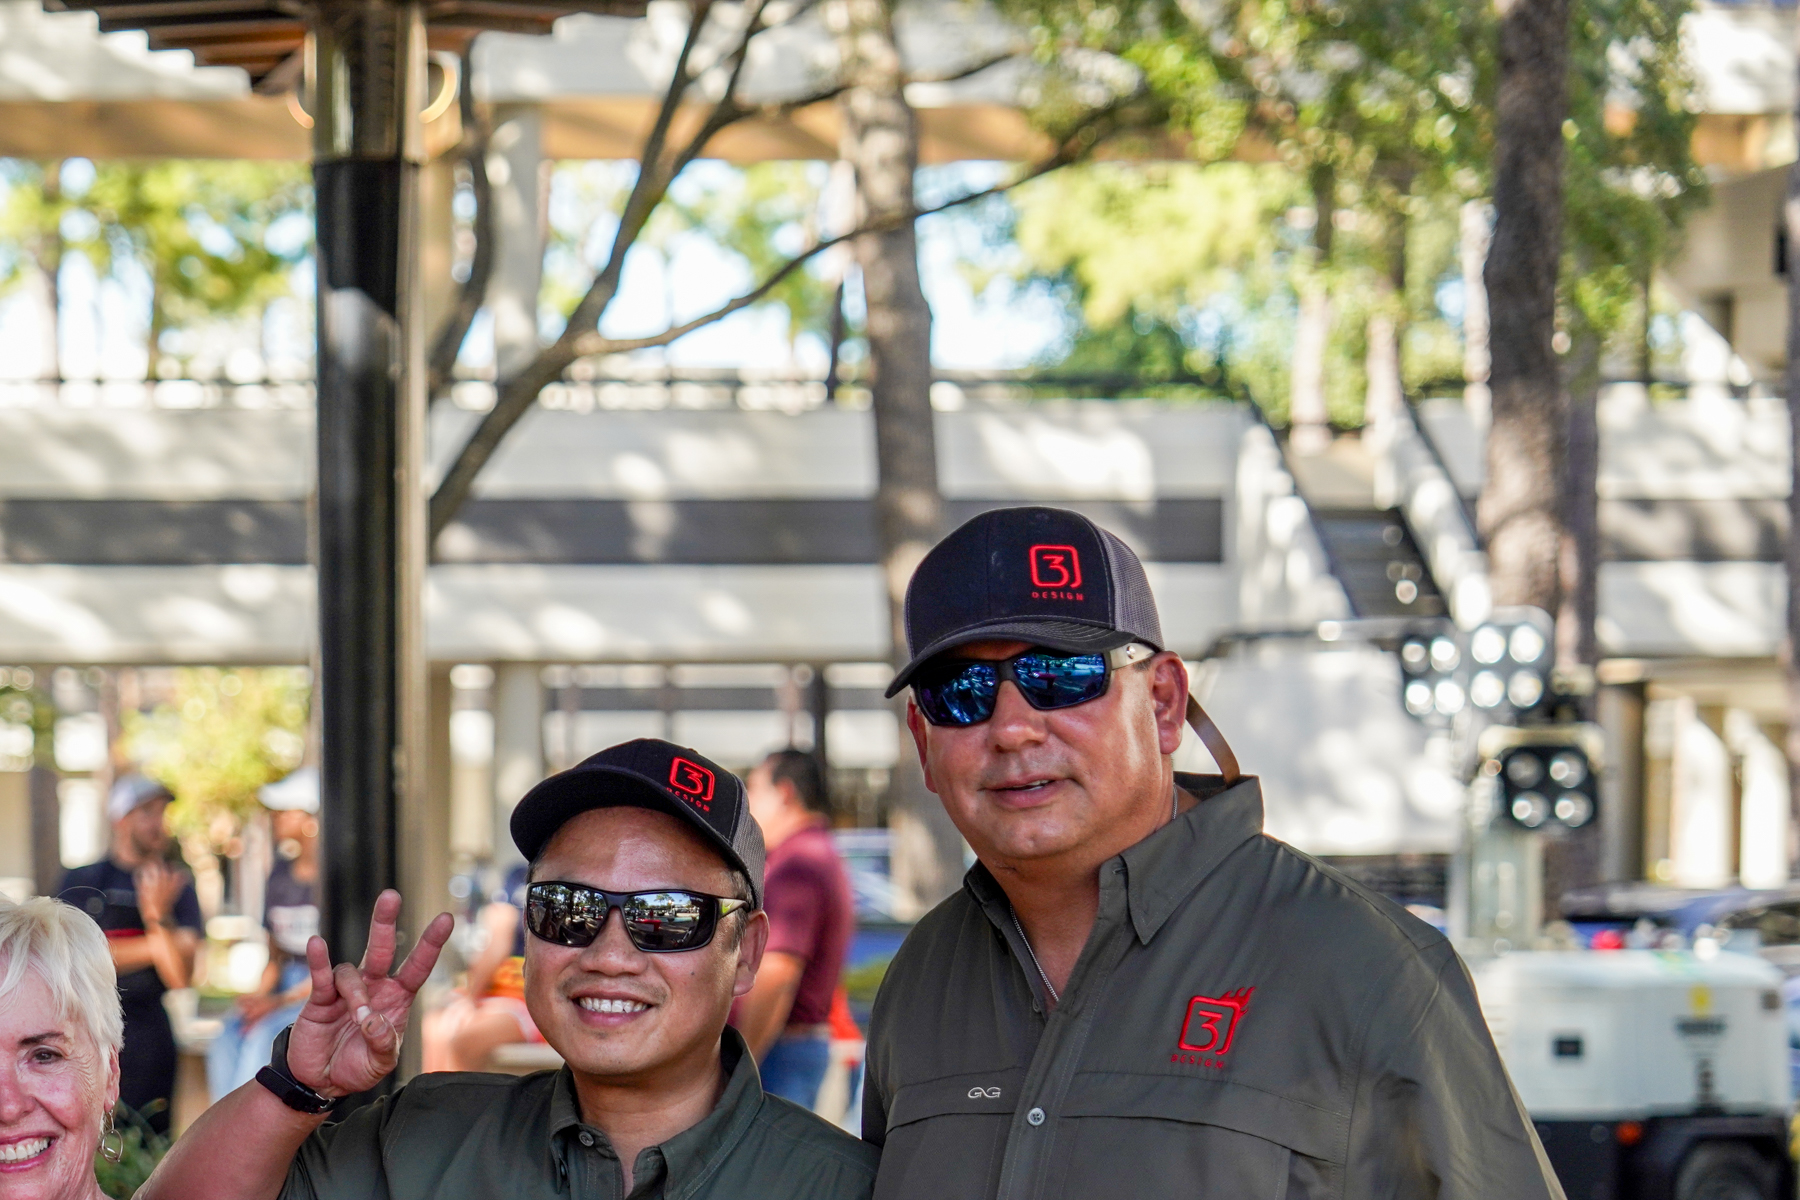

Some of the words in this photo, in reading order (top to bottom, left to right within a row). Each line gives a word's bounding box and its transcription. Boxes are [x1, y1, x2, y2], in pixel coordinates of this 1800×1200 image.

[1032, 591, 1084, 601] DESIGN
[666, 787, 710, 812] DESIGN
[1170, 1053, 1224, 1069] DESIGN
